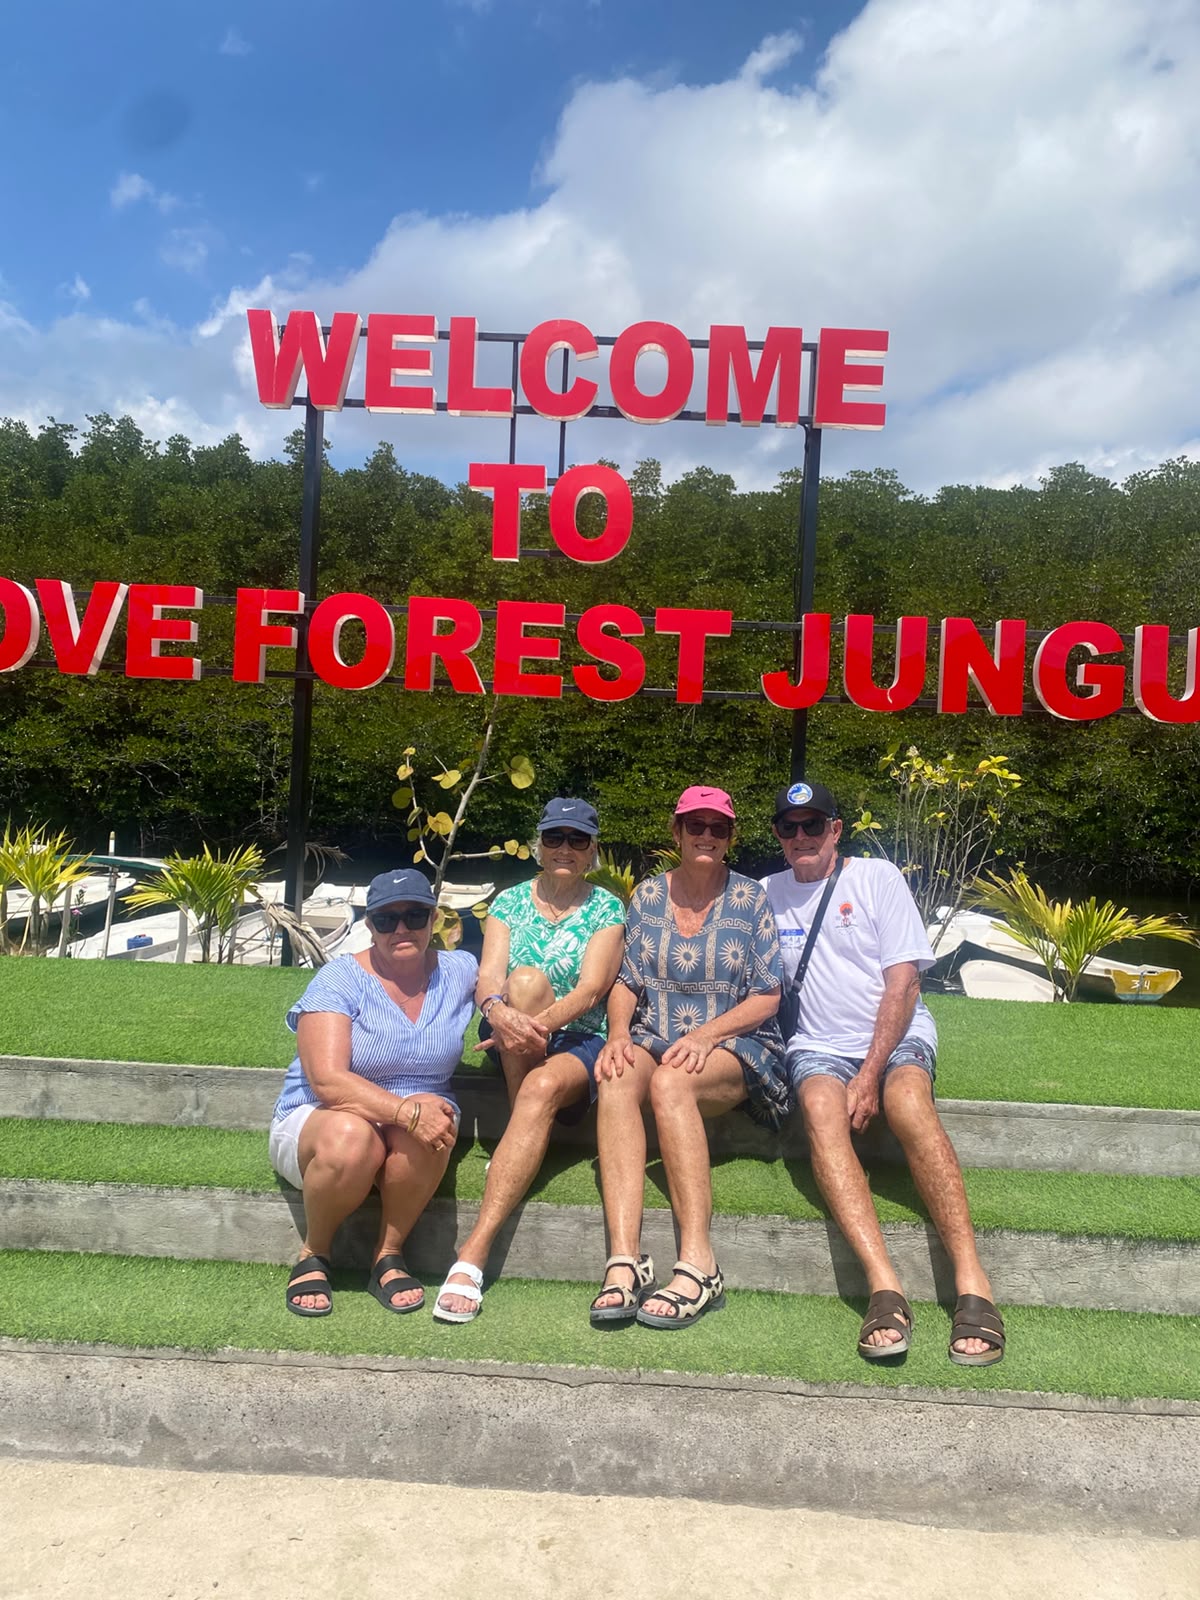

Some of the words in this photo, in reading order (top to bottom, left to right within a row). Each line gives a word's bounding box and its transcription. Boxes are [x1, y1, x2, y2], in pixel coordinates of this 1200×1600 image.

[247, 309, 889, 431] WELCOME
[469, 462, 633, 564] TO
[233, 587, 732, 705] FOREST
[761, 612, 1200, 723] JUNGU
